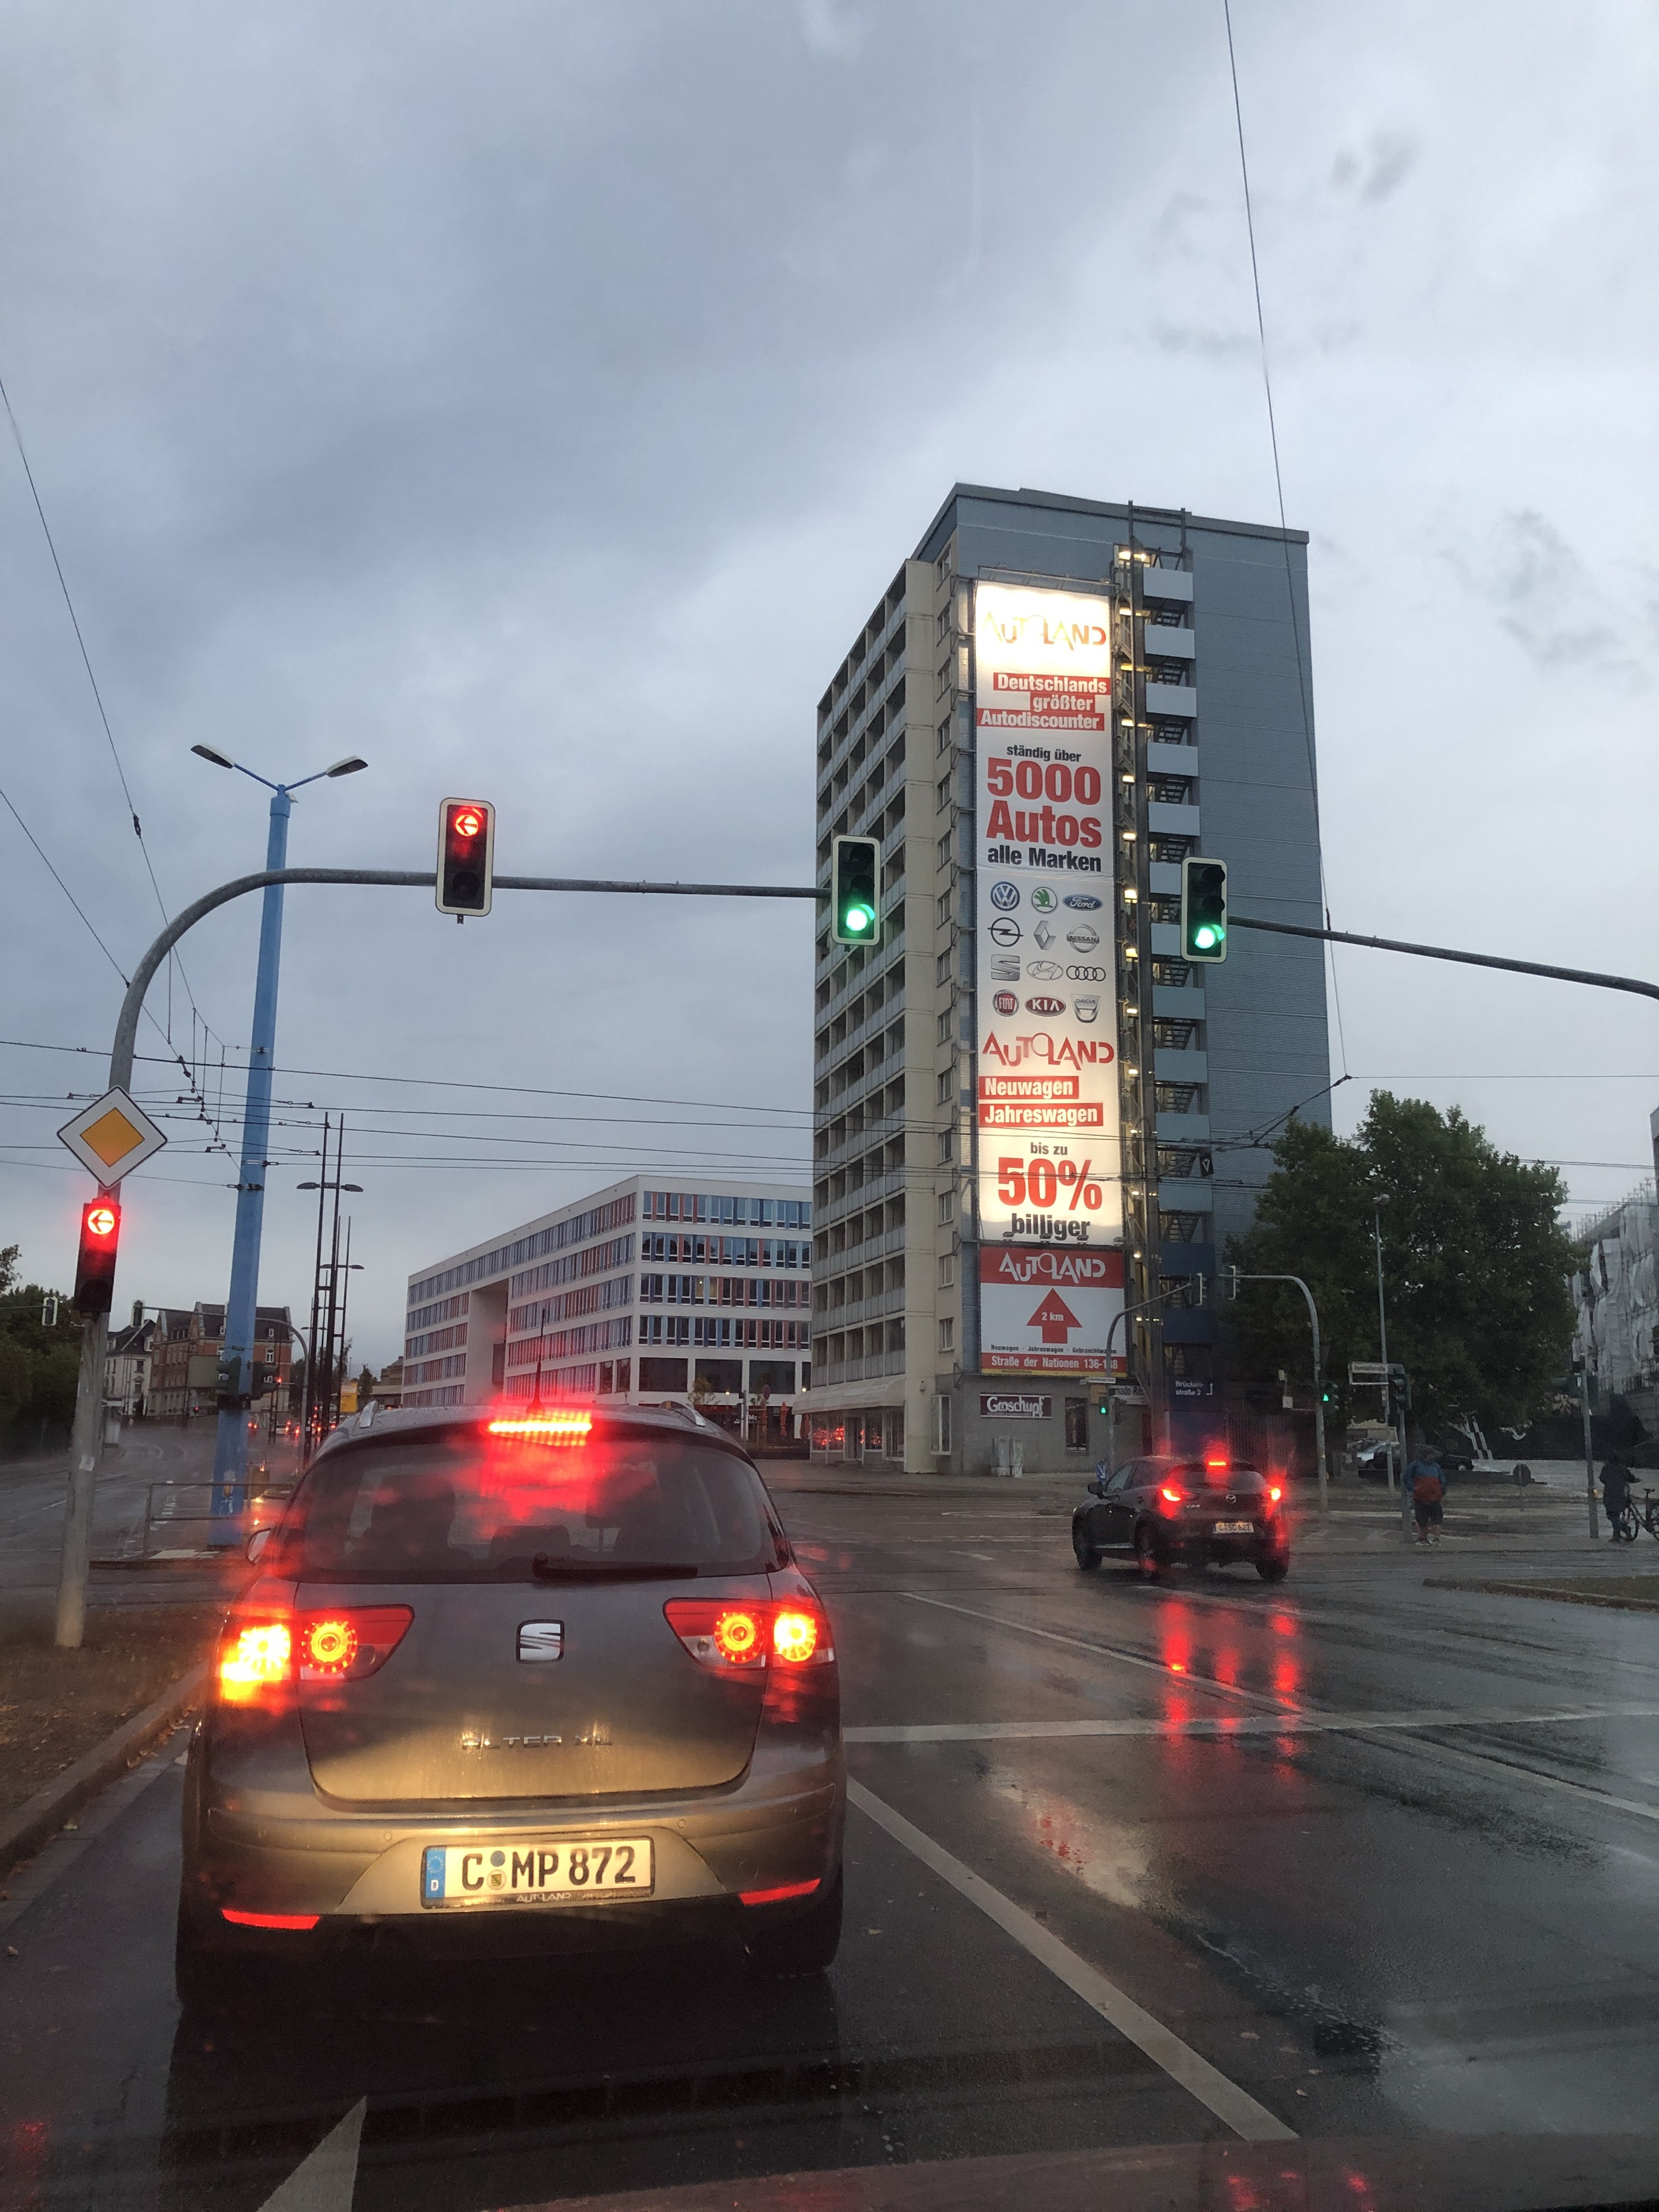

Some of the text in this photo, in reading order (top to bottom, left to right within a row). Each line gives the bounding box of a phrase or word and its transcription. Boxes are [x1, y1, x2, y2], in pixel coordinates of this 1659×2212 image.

[998, 674, 1107, 693] Deutschlands
[1033, 695, 1093, 712] größter
[981, 710, 1099, 729] Autodiscounter
[1007, 745, 1081, 762] ständig über
[987, 757, 1101, 805] 5000
[986, 800, 1102, 848] Autos
[987, 844, 1101, 872] alle Marken
[1070, 896, 1096, 908] Ford
[999, 997, 1014, 1010] FIAT
[1032, 999, 1059, 1011] KIA
[982, 1031, 1114, 1070] AUTOLAND
[985, 1078, 1073, 1099] Neuwagen
[984, 1105, 1097, 1126] Jahreswagen
[1030, 1142, 1067, 1155] bis zu
[998, 1157, 1103, 1210] 50%
[1012, 1213, 1090, 1240] billiger
[999, 1252, 1105, 1283] AUTOLAND
[1041, 1312, 1063, 1321] 2 km
[991, 1355, 1019, 1366] Straße
[1024, 1357, 1037, 1367] der
[1043, 1357, 1079, 1368] Nationen
[462, 1853, 484, 1891] C
[512, 1850, 559, 1888] MP
[569, 1846, 636, 1886] 872
